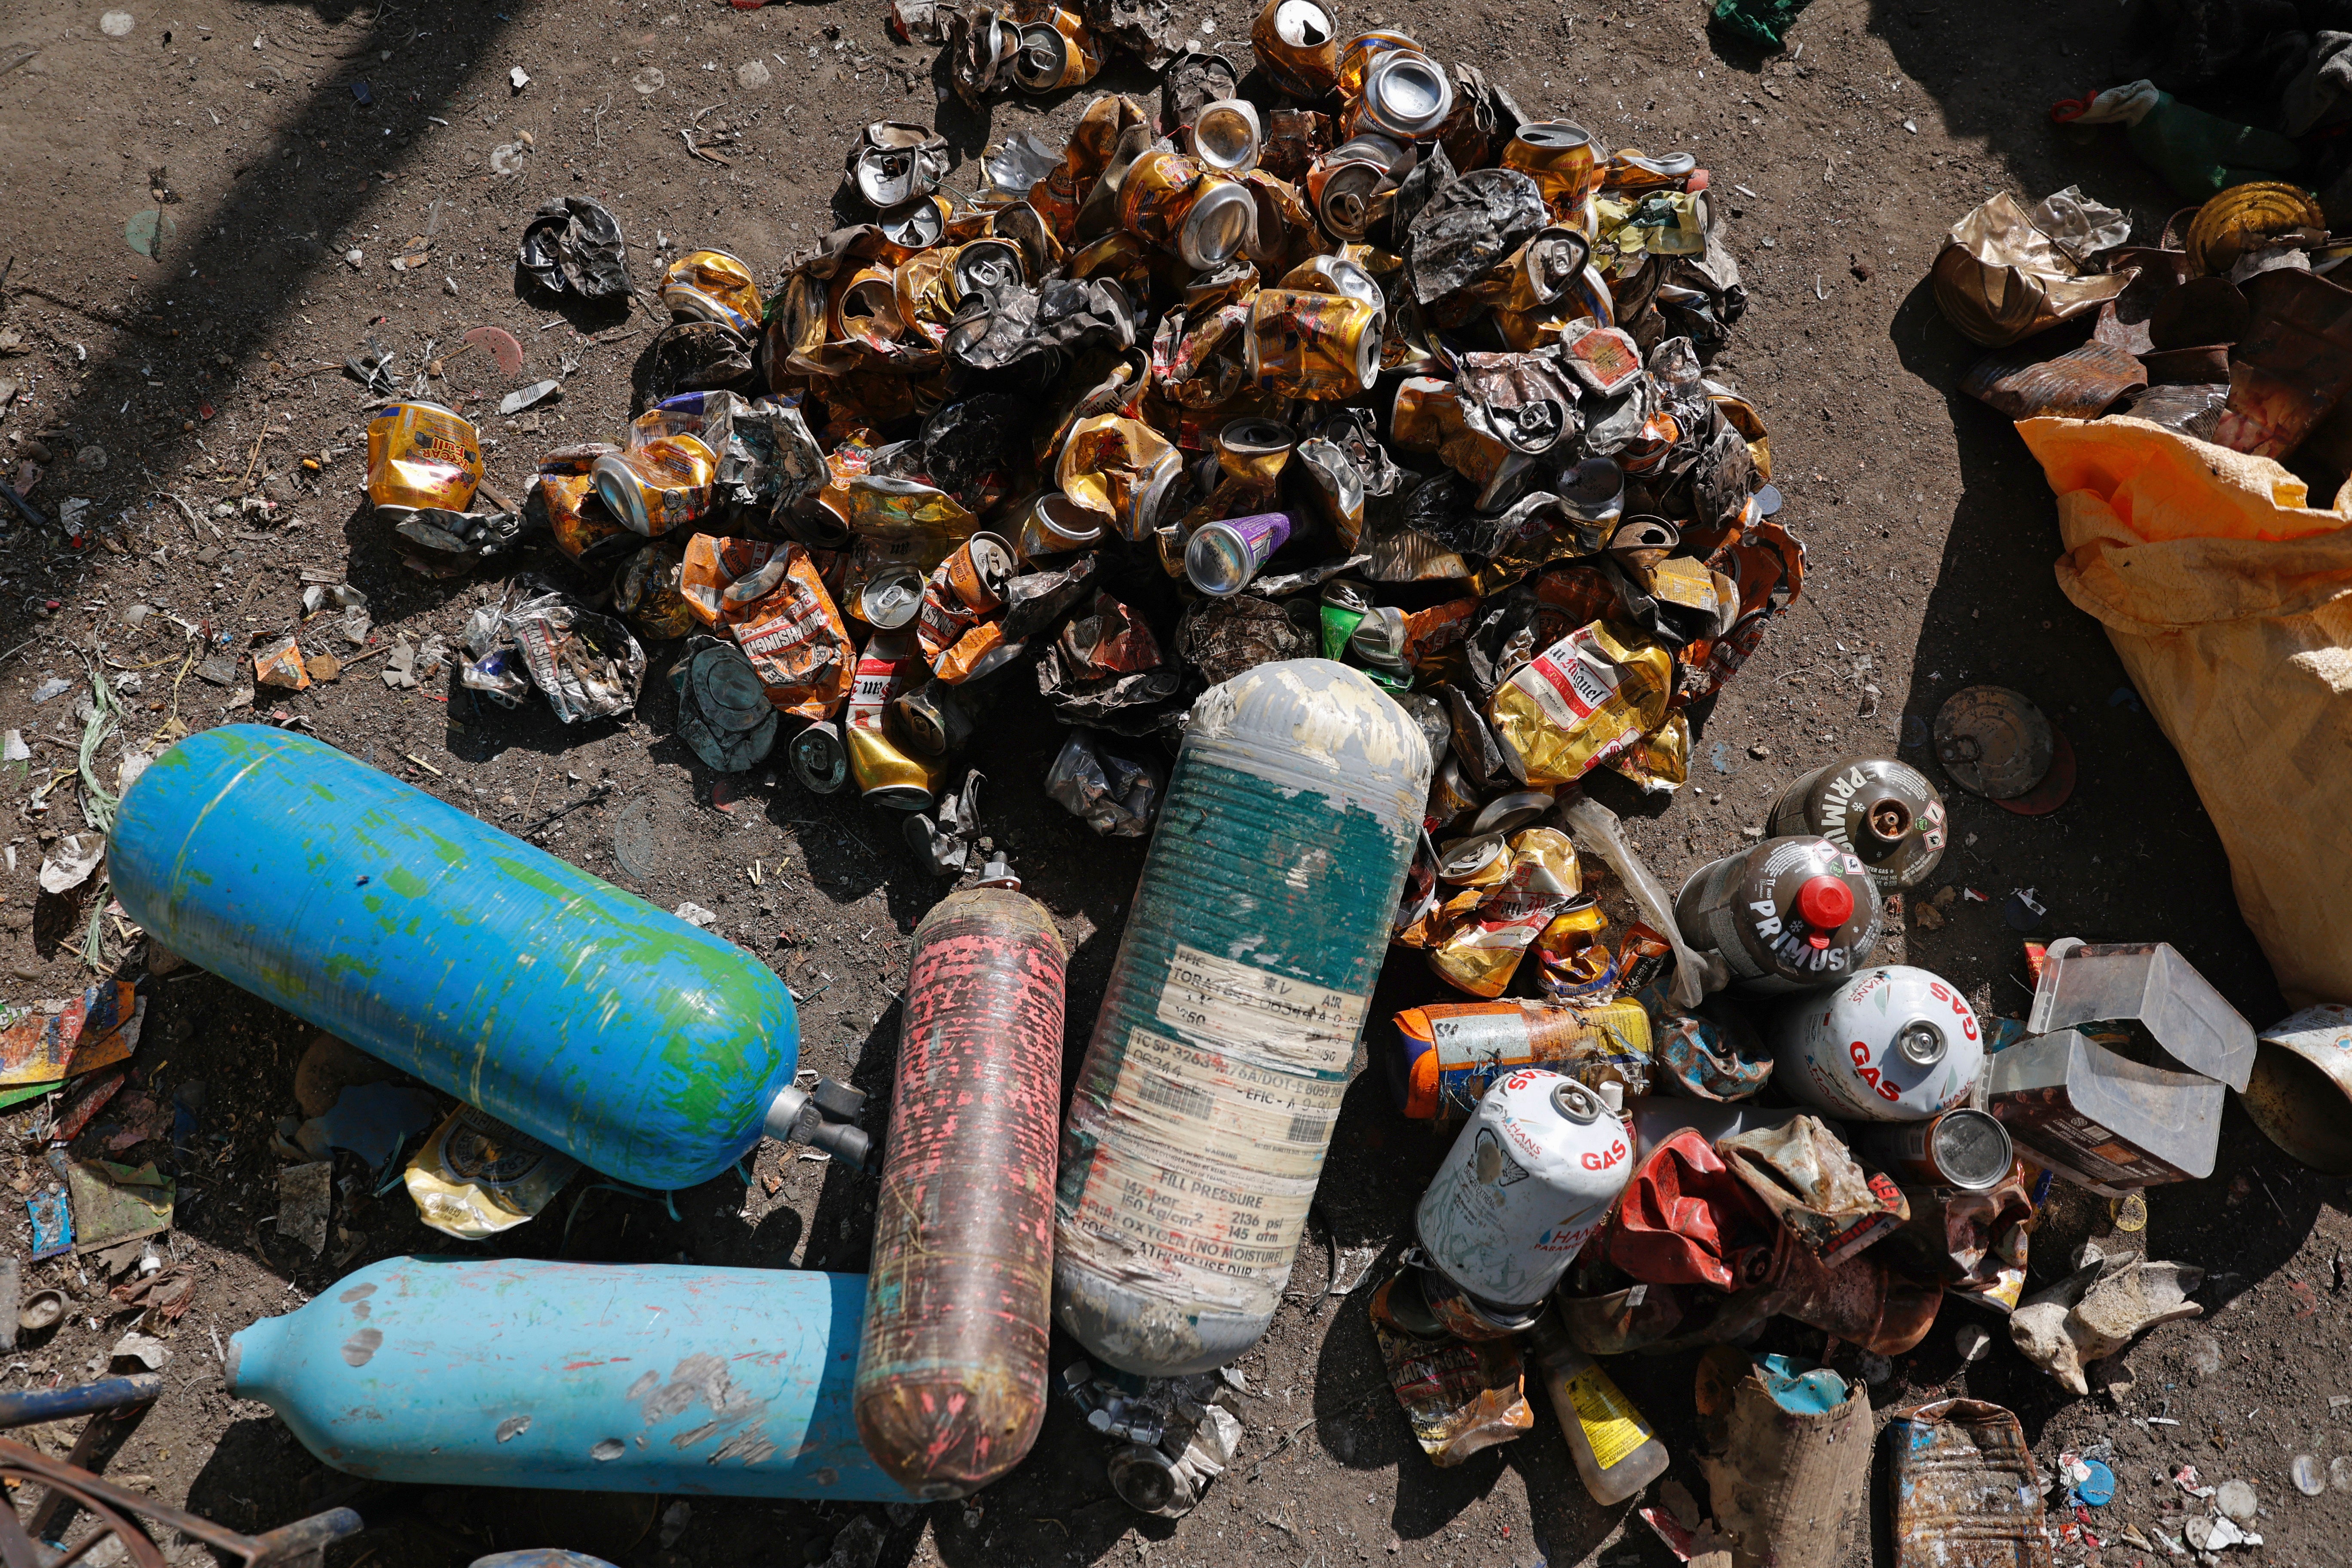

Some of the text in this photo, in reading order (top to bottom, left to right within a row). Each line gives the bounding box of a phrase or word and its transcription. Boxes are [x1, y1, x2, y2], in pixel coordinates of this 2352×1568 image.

[433, 437, 465, 457] Full
[1560, 658, 1607, 702] Miguel
[863, 681, 896, 701] San
[1749, 900, 1844, 971] PRIMUS
[1264, 976, 1292, 994] 東レ
[1537, 979, 1560, 992] ENERGY
[1322, 995, 1342, 1009] AIR
[1930, 982, 1977, 1041] GAS
[1136, 1032, 1151, 1047] TC
[1153, 1039, 1170, 1053] SP
[1305, 1084, 1330, 1097] 8059
[1850, 1041, 1902, 1102] GAS
[1508, 1070, 1557, 1090] GAS
[1246, 1088, 1274, 1104] EFIC
[1510, 1123, 1543, 1155] HANS
[1205, 1146, 1237, 1161] WARNING
[1581, 1139, 1626, 1171] GAS
[1464, 1166, 1479, 1189] DANGER
[1152, 1189, 1180, 1206] bar
[1160, 1170, 1263, 1208] FILL PRESSURE
[1122, 1194, 1143, 1211] 150
[1232, 1211, 1260, 1226] 2136
[1123, 1217, 1188, 1248] OXYGEN
[1191, 1238, 1219, 1255] (NO
[1222, 1246, 1283, 1265] MOISTURE)
[1228, 1226, 1278, 1243] 145 atm
